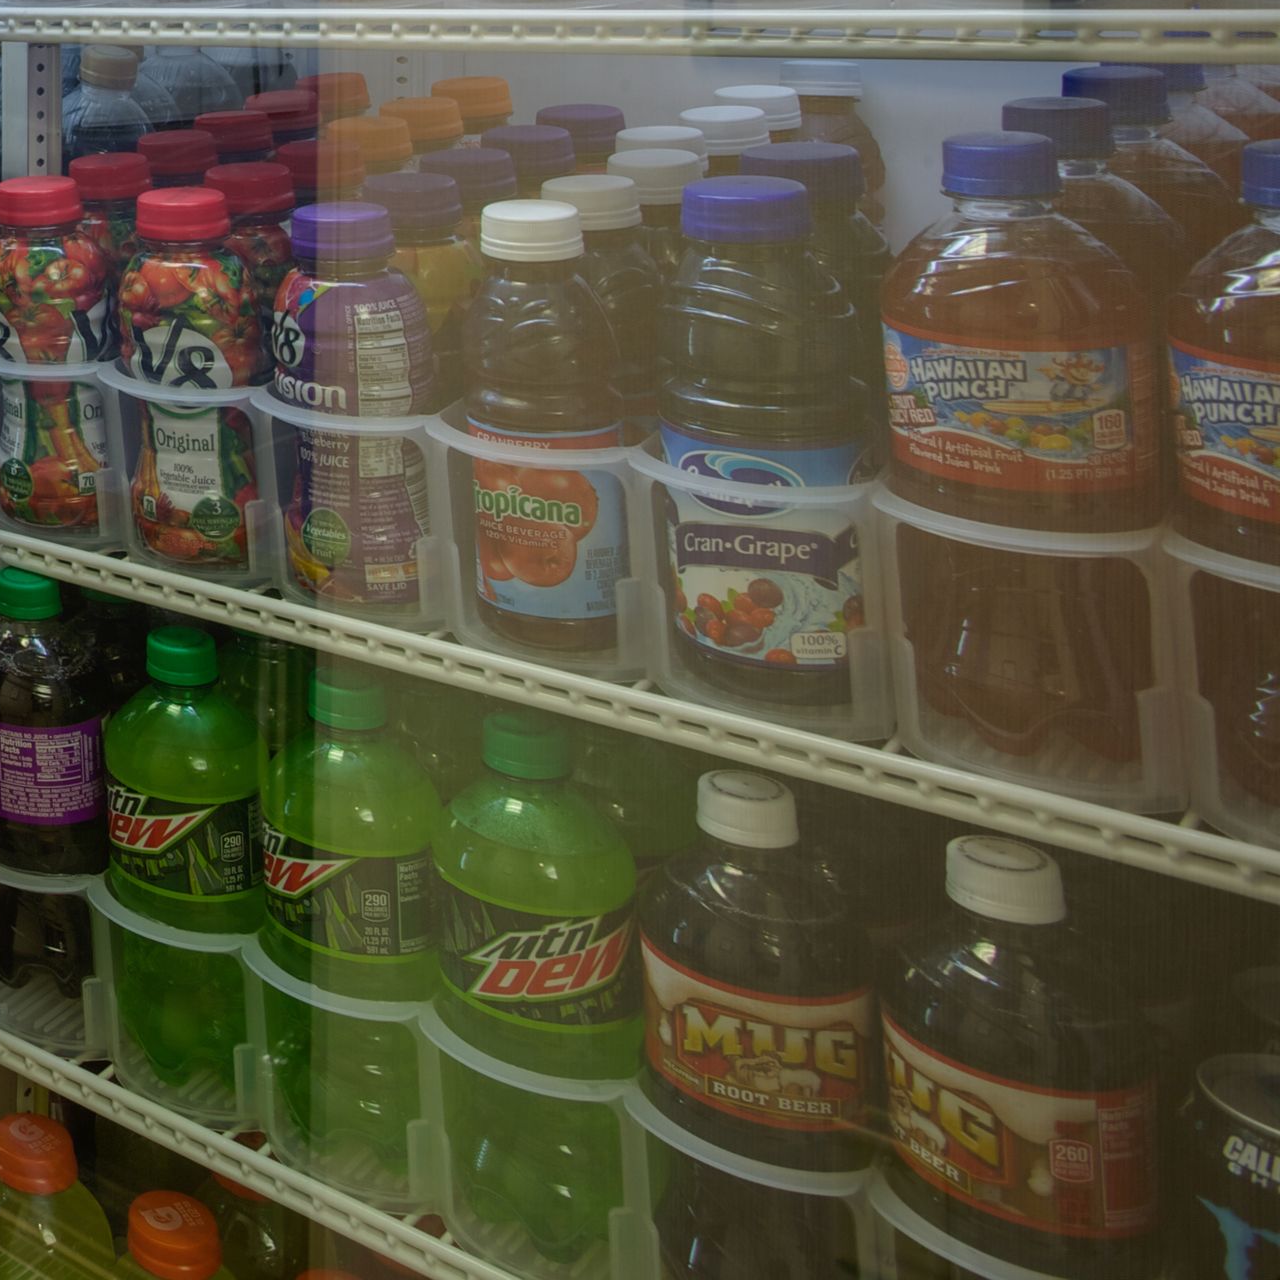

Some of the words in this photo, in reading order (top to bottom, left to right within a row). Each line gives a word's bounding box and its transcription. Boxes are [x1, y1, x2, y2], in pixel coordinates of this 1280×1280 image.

[354, 302, 377, 314] 100%
[377, 299, 397, 311] JUICE
[131, 313, 218, 389] V8
[910, 357, 1027, 383] HAWAIIAN
[925, 380, 1010, 404] PUNCH
[911, 410, 935, 426] RED
[1098, 413, 1123, 431] 160
[1192, 401, 1278, 426] PUNCH
[155, 428, 215, 454] Original
[476, 432, 551, 450] CRANBERRY
[319, 448, 350, 468] JUICE
[945, 441, 993, 460] Artificial
[995, 449, 1023, 463] Fruit
[173, 463, 194, 474] 100%
[945, 454, 971, 469] Juice
[973, 460, 1003, 476] Drink
[83, 475, 95, 487] 70
[191, 474, 216, 486] Juice
[213, 501, 221, 515] 3
[305, 524, 346, 540] Vegetables
[486, 529, 507, 541] 120%
[510, 534, 549, 548] Vitamin
[505, 525, 569, 539] BEVERAGE
[366, 582, 387, 592] SAVE
[389, 581, 407, 591] LID
[800, 634, 839, 647] 100%
[796, 646, 833, 656] vitamin
[834, 644, 843, 656] C
[0, 737, 33, 749] Nutrition
[0, 746, 20, 755] Facts
[224, 835, 242, 848] 290
[364, 893, 387, 907] 290
[681, 1003, 859, 1080] MUG
[712, 1081, 769, 1107] ROOT
[777, 1097, 833, 1115] BEER
[910, 1138, 961, 1182] BEER
[1055, 1144, 1088, 1162] 260
